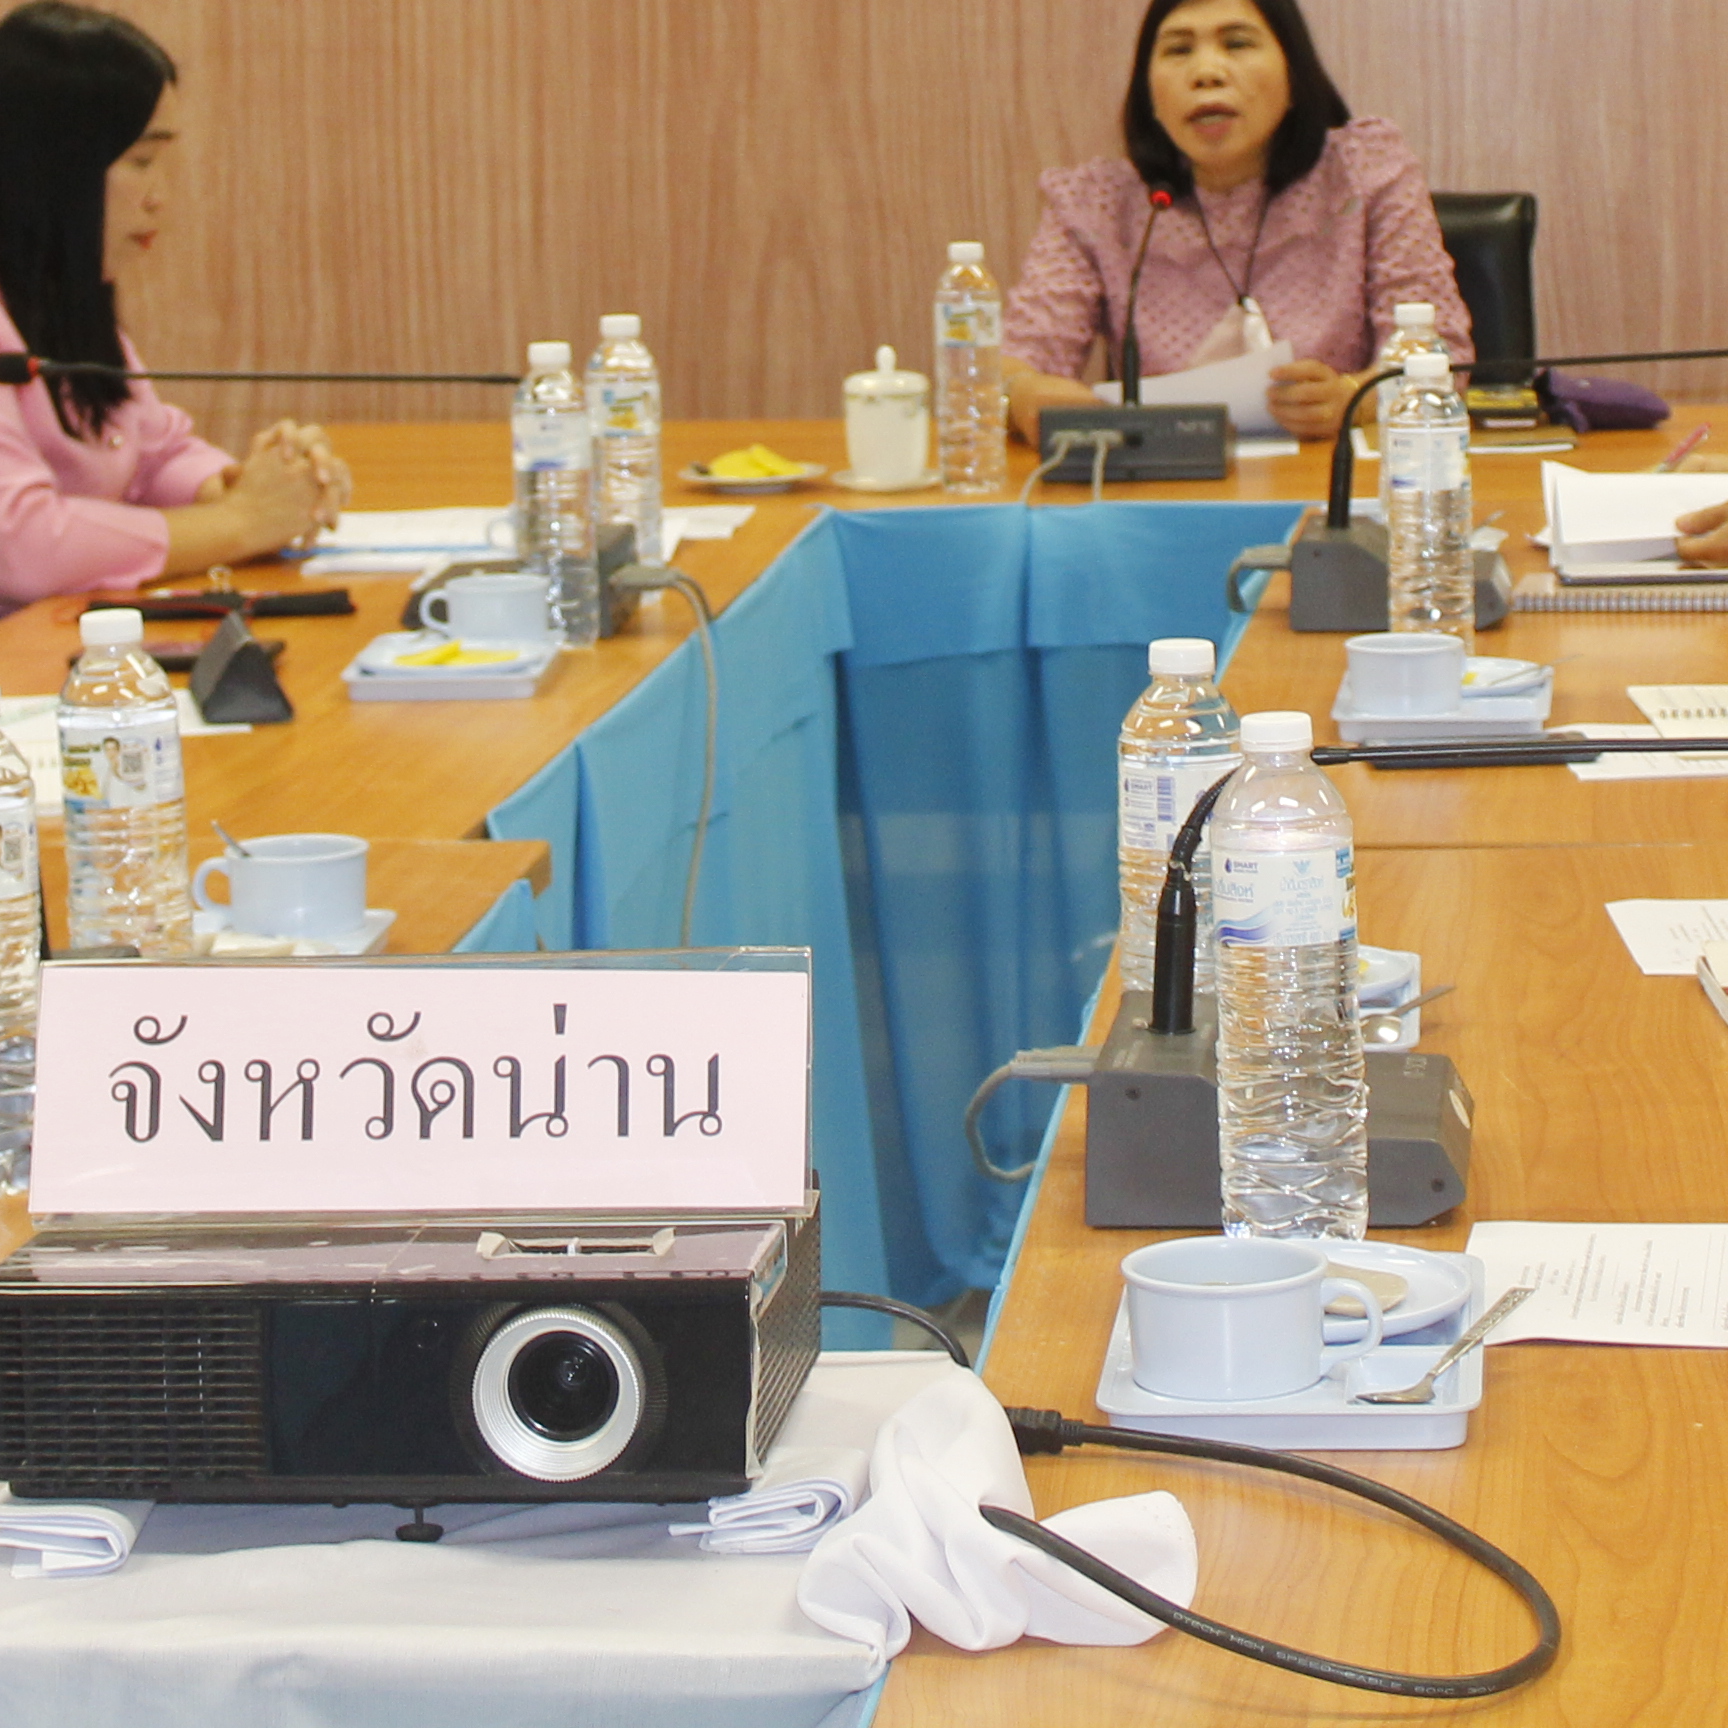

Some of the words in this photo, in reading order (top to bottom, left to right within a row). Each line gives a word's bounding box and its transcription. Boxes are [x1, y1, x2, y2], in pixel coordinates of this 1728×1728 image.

[108, 1003, 723, 1142] จังหวัดน่าน
